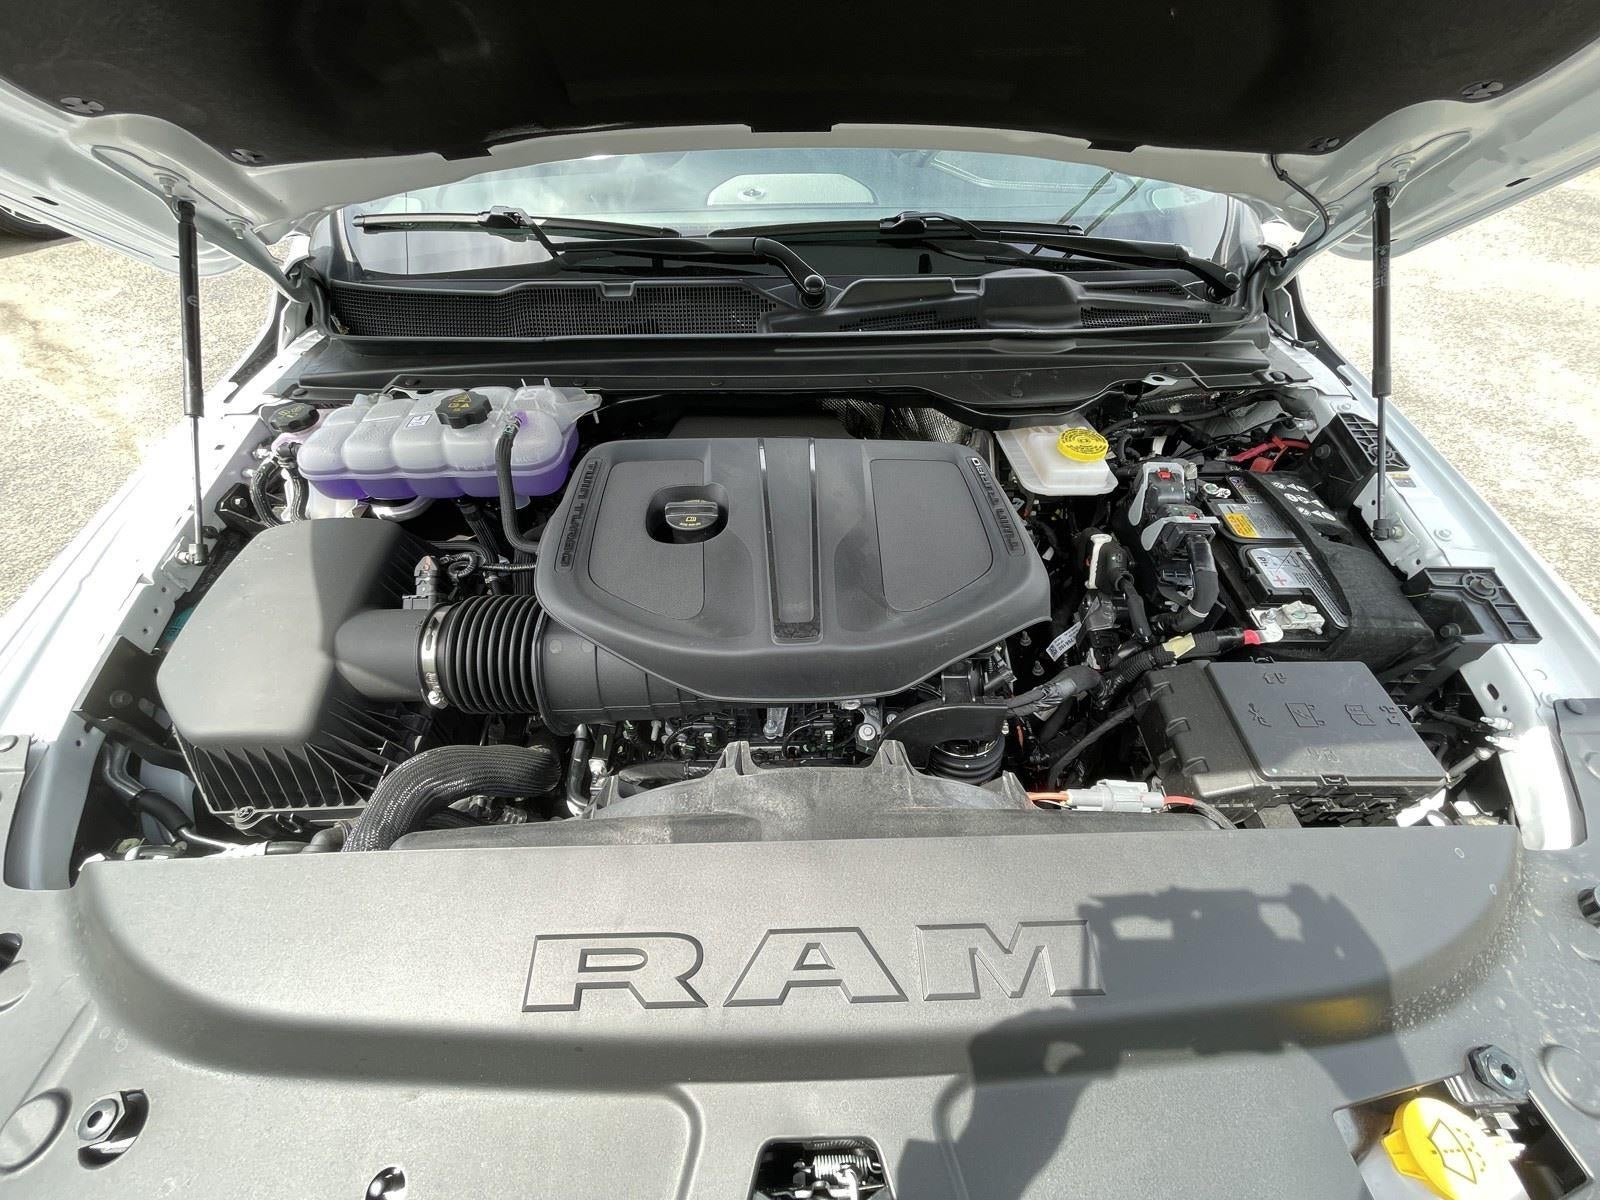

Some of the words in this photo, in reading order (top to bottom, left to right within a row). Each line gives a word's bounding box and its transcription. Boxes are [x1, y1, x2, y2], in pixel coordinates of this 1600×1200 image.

[578, 461, 598, 500] TWIN
[971, 457, 1000, 508] TURBO
[560, 502, 585, 567] TURBO
[521, 918, 1106, 1013] RAM
